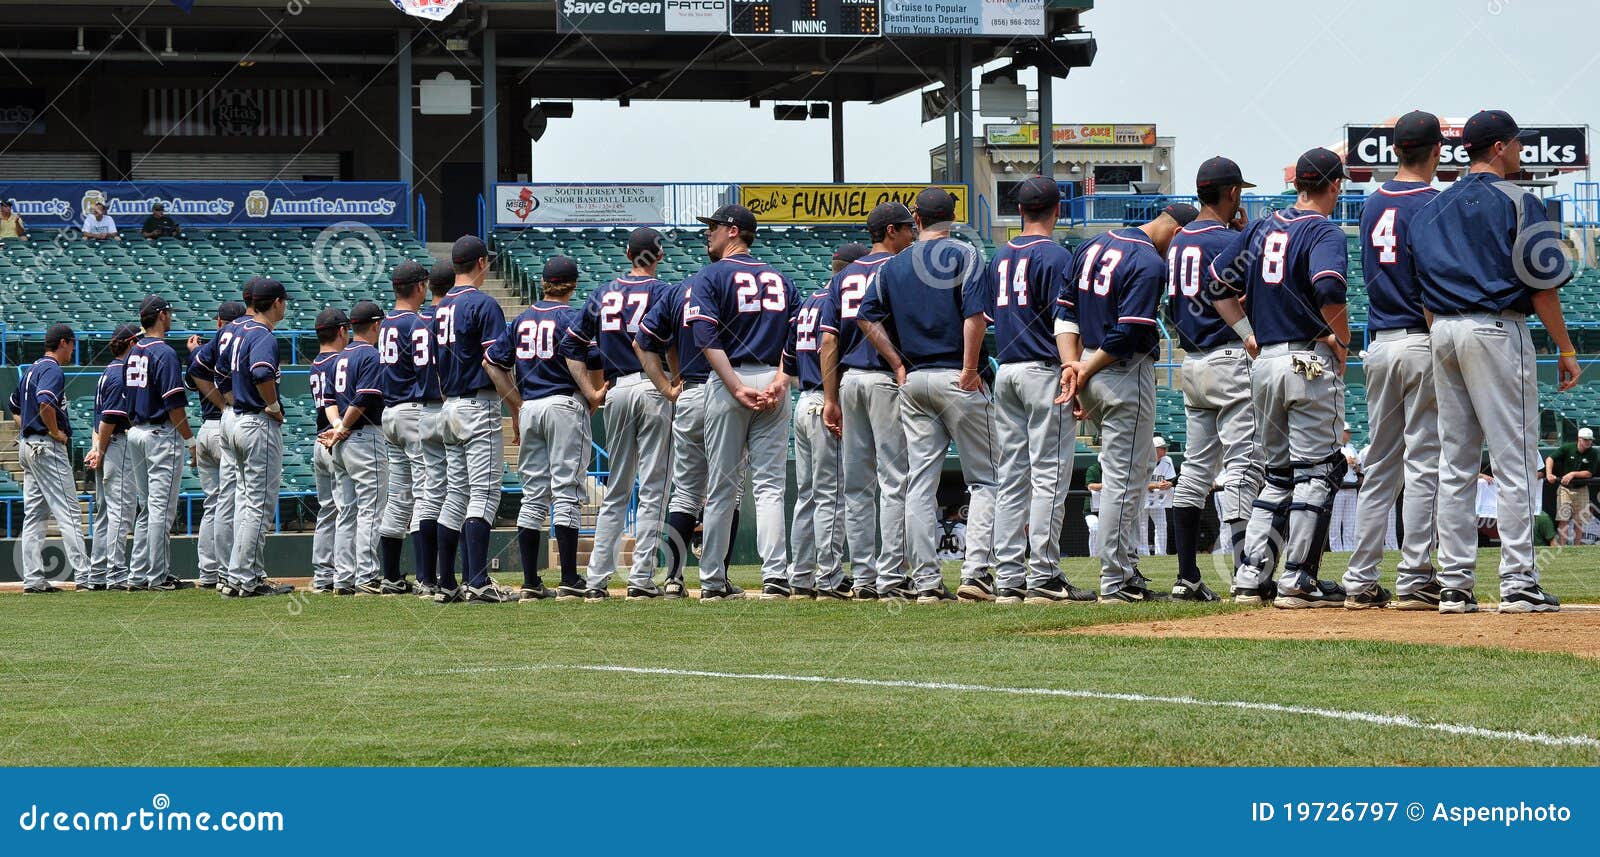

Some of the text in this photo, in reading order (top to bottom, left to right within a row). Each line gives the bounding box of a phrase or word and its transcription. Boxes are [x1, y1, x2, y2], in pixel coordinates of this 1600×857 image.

[608, 0, 662, 14] Green
[667, 1, 725, 10] PATCO
[925, 3, 933, 12] to
[935, 4, 967, 14] Popular
[791, 20, 827, 33] INNING
[884, 14, 979, 25] Destinations Departing
[891, 25, 910, 34] from
[913, 25, 931, 34] Your
[218, 104, 257, 121] Rita's
[1080, 127, 1111, 138] CAKE
[1116, 135, 1128, 144] ICE
[577, 196, 621, 204] BASEBALL
[622, 196, 656, 204] LEAGUE
[586, 188, 616, 196] JERSEY
[748, 191, 787, 216] Rick's
[791, 191, 869, 218] FUNNEL
[1370, 207, 1397, 264] 4
[1077, 242, 1123, 297] 13
[1167, 245, 1202, 297] 10
[1261, 230, 1290, 285] 8
[734, 271, 786, 313] 23
[996, 256, 1029, 307] 14
[435, 305, 457, 346] 31
[600, 290, 650, 334] 27
[515, 319, 556, 360] 30
[125, 353, 150, 389] 28
[334, 357, 349, 394] 6
